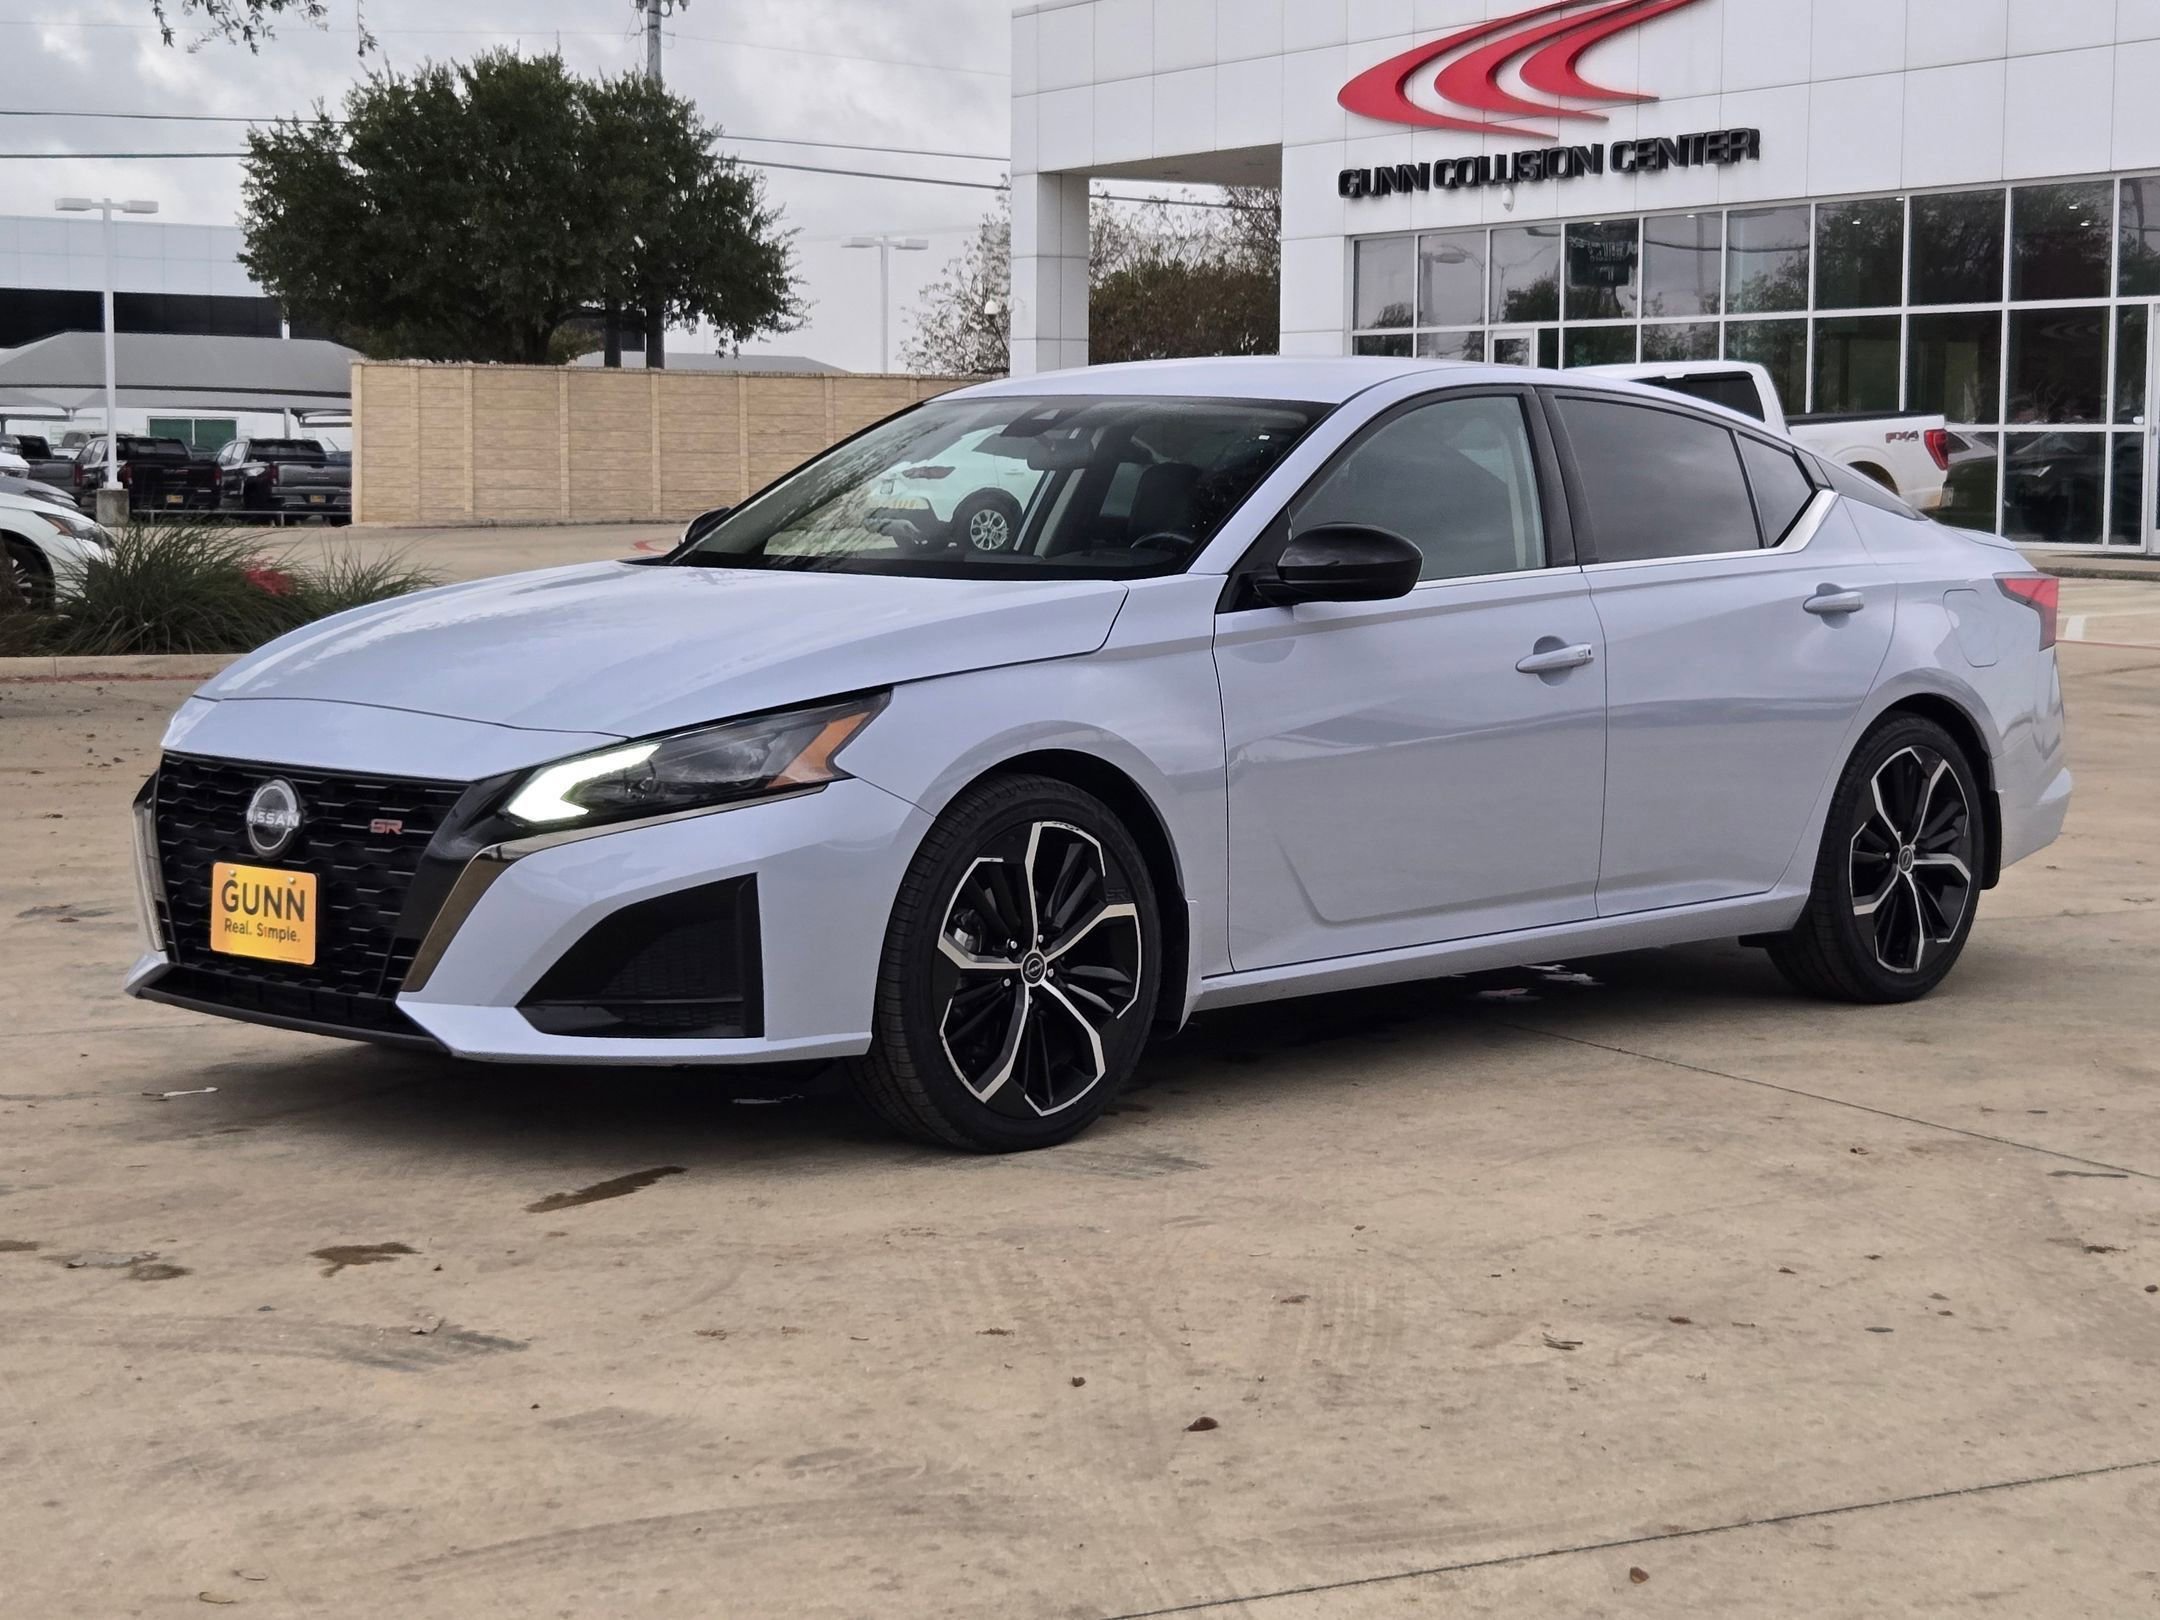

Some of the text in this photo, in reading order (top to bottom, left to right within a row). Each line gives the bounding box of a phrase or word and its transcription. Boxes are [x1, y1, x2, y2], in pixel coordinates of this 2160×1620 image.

[1338, 127, 1761, 199] GUNN COLLISION CENTER
[370, 818, 402, 834] SR
[221, 879, 306, 922] GUNN
[224, 918, 300, 943] Real. Simple.
